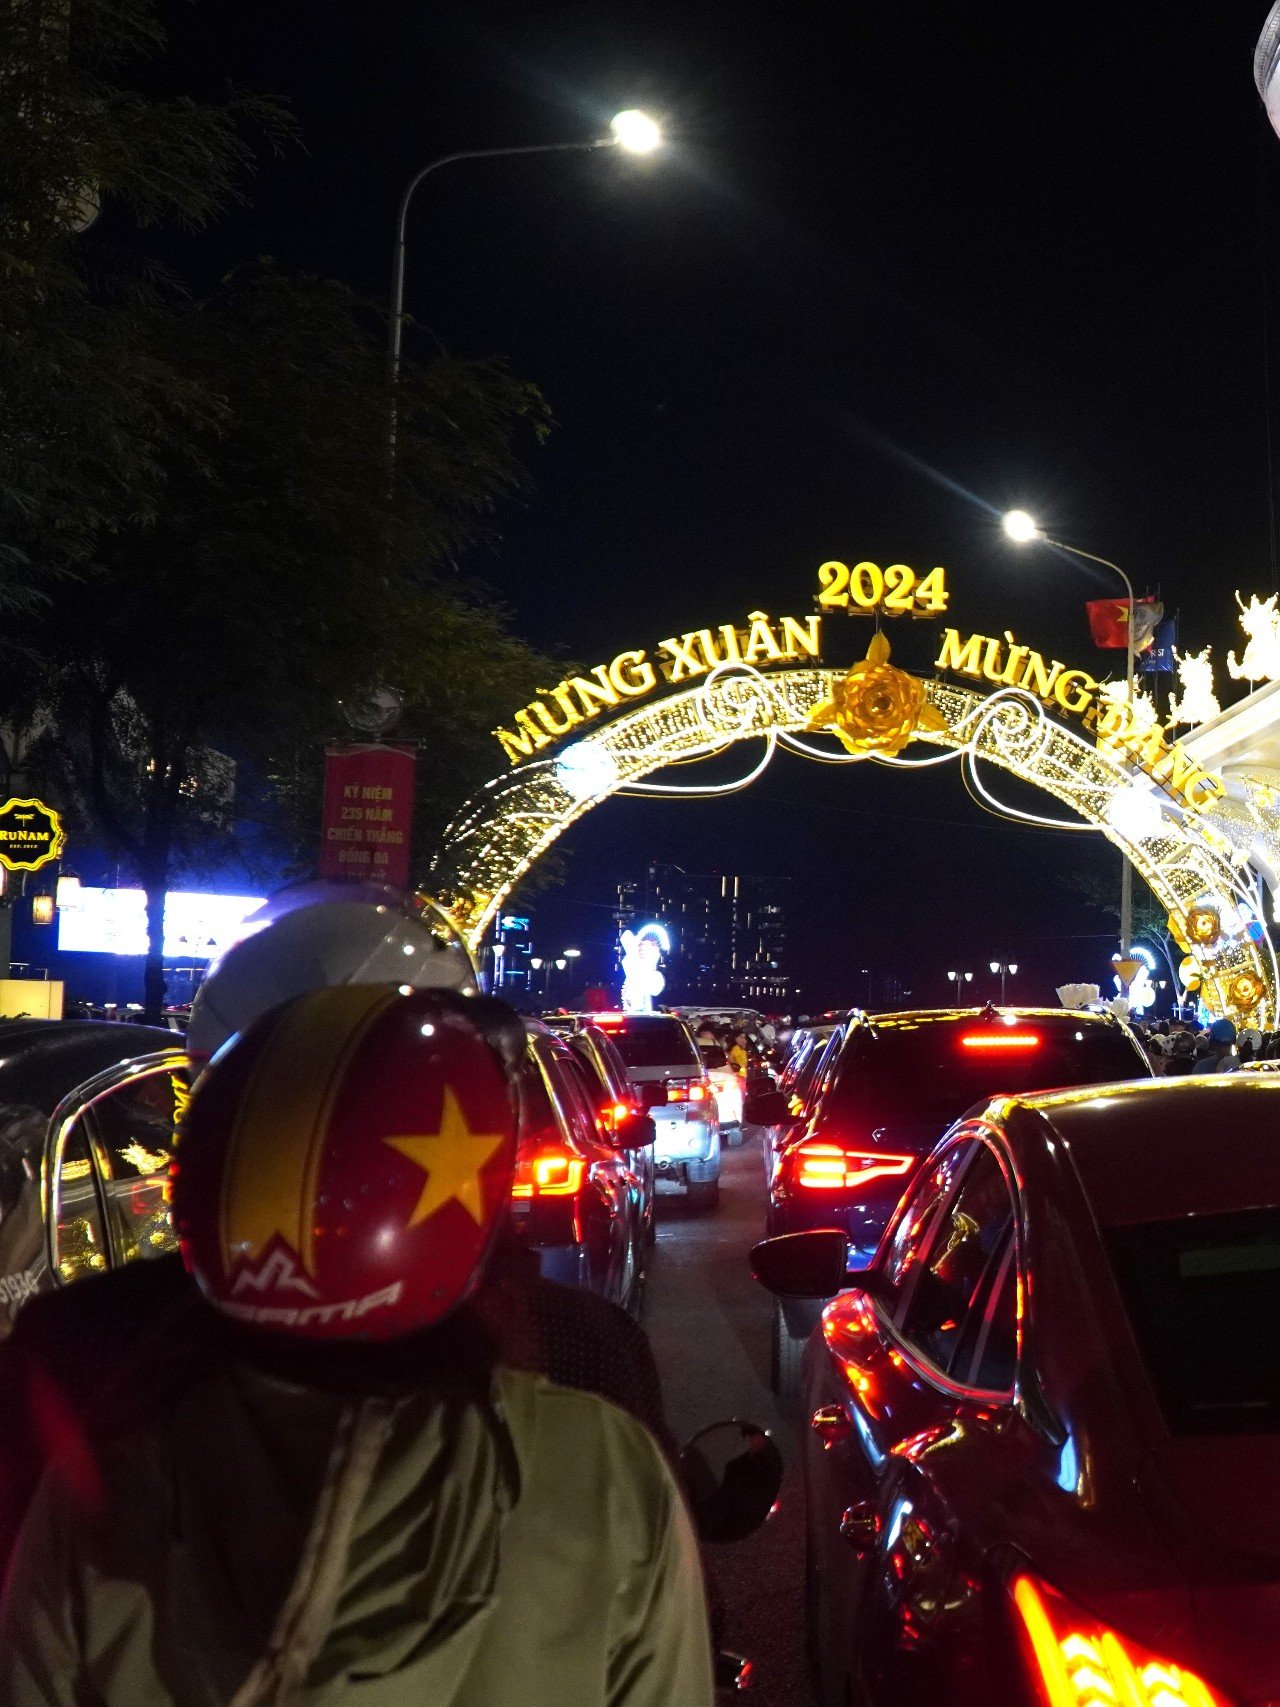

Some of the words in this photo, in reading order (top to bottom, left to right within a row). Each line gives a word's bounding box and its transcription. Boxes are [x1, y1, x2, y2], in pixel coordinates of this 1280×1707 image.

[818, 561, 949, 611] 2024
[658, 611, 821, 683] XUÂN
[935, 631, 1099, 713] MỪNG
